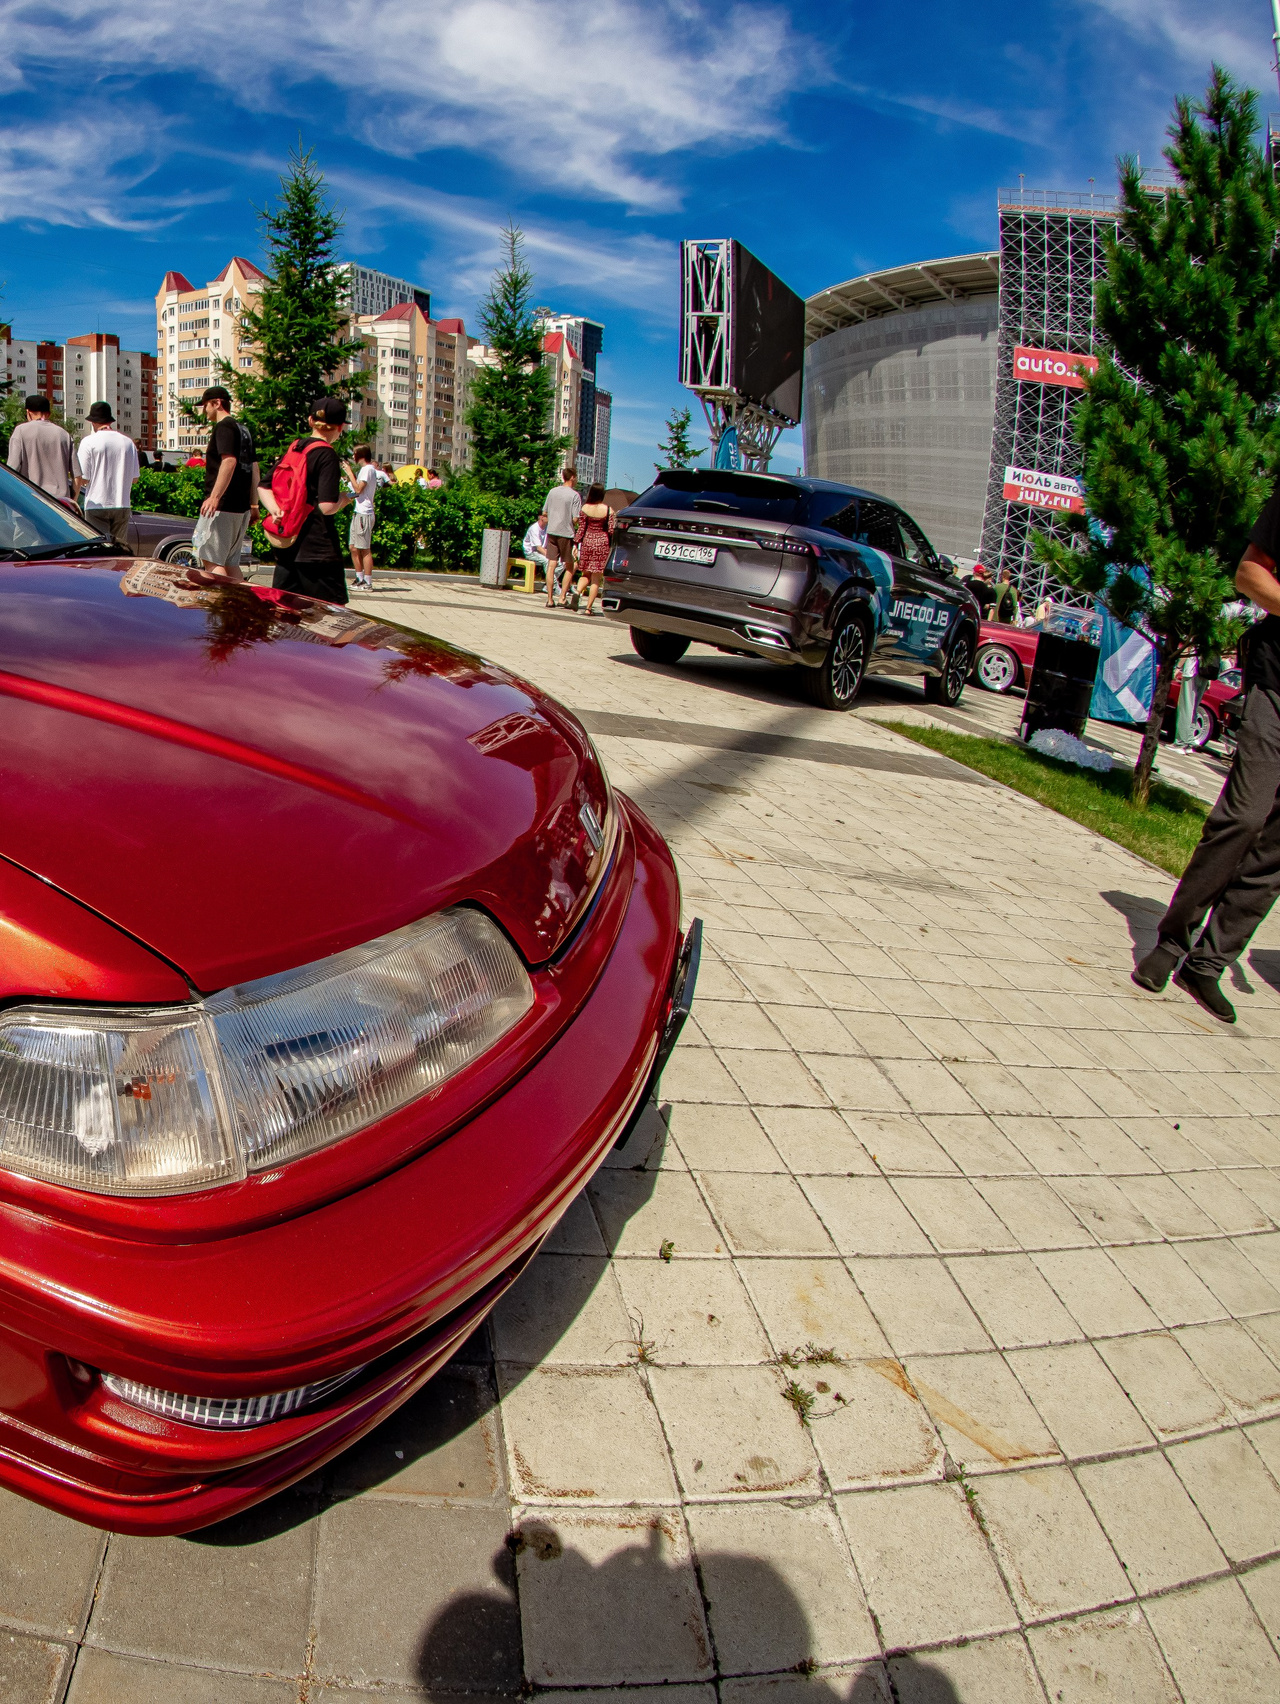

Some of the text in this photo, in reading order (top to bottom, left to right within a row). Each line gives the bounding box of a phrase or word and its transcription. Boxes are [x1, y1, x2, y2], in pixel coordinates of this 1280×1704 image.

[1017, 356, 1094, 378] auto.
[1054, 482, 1079, 494] авто
[1017, 487, 1072, 509] july.ru
[699, 547, 713, 558] 196
[932, 609, 950, 627] J8
